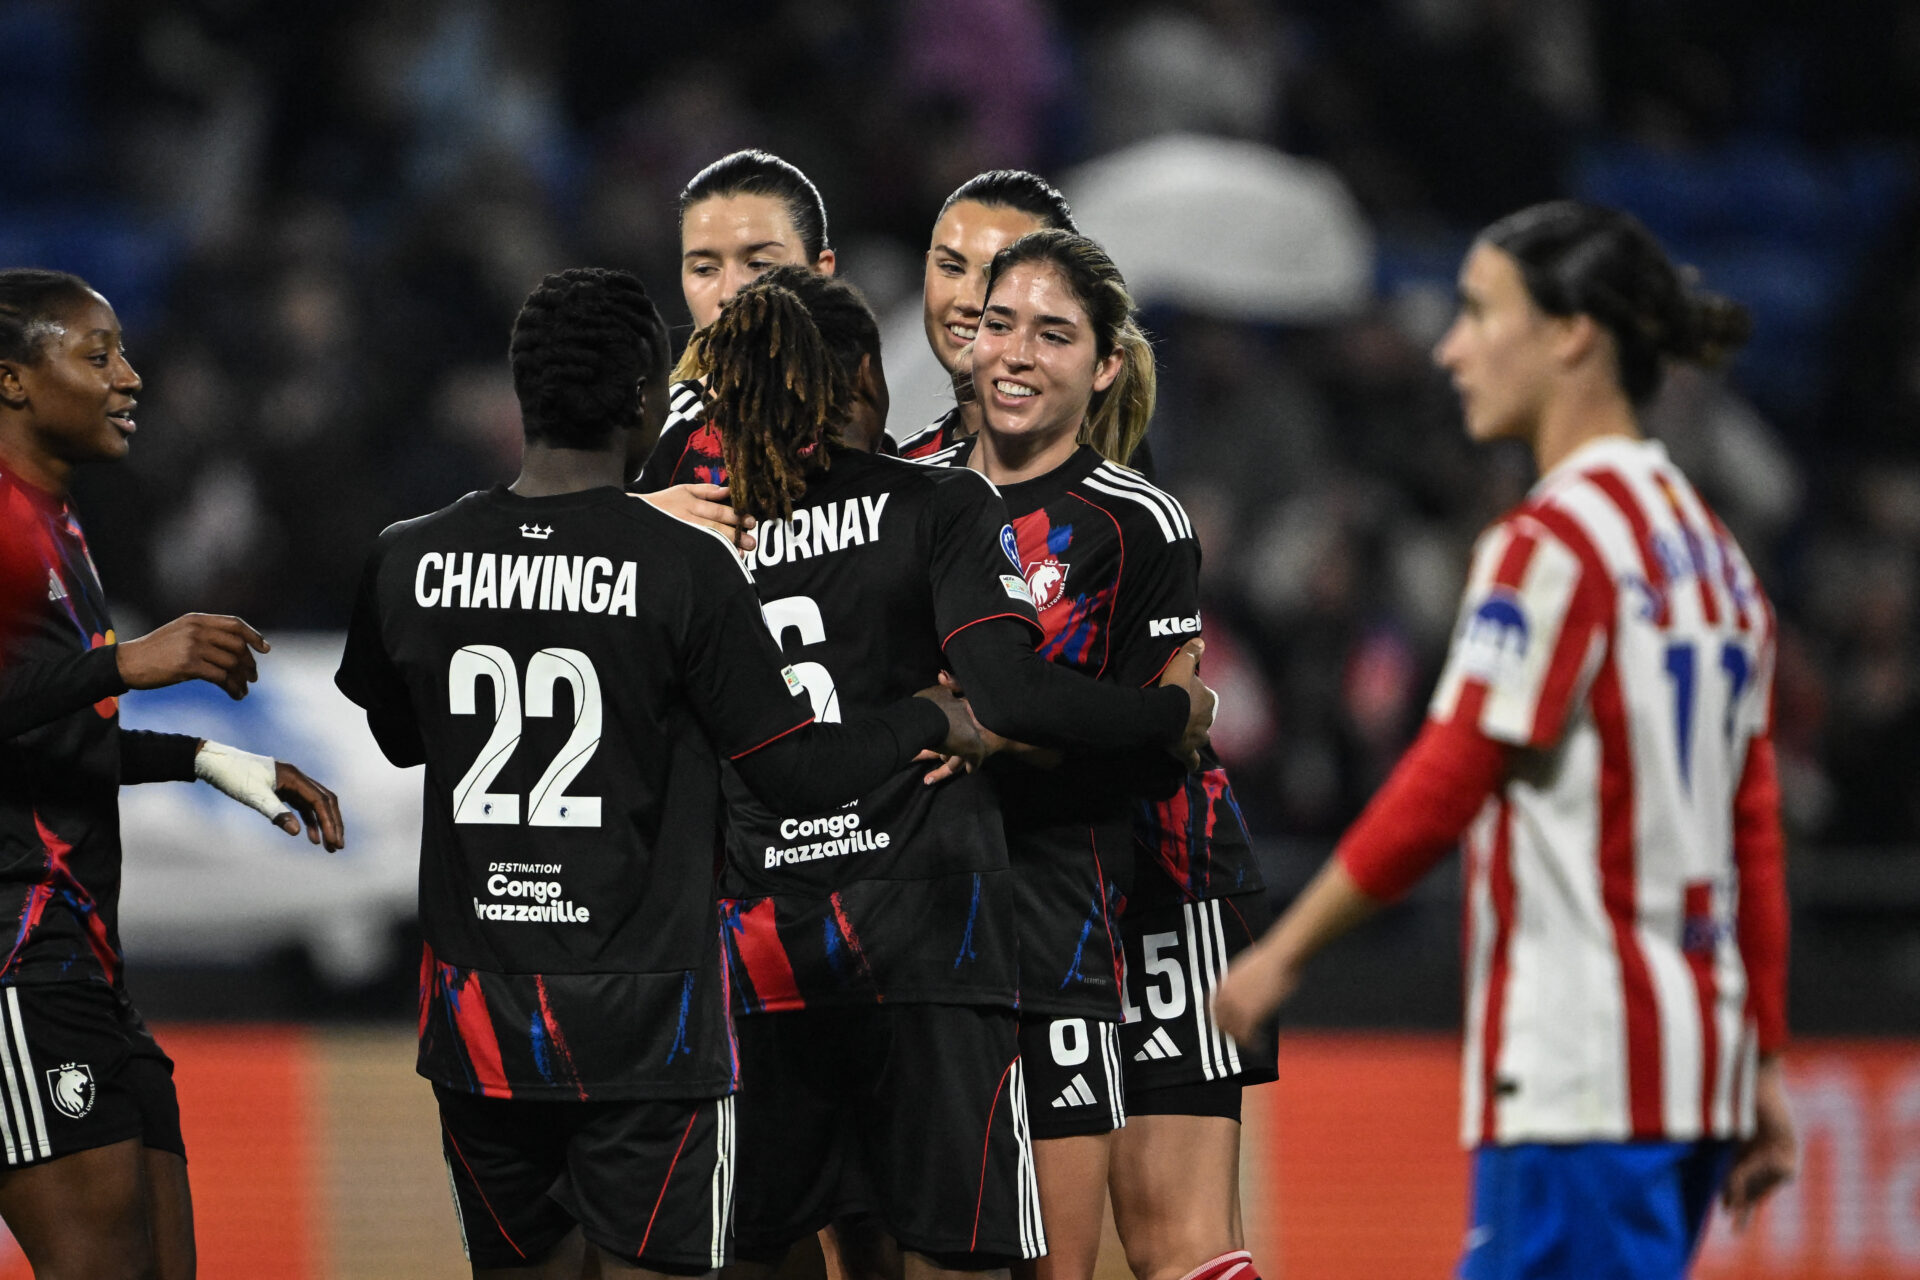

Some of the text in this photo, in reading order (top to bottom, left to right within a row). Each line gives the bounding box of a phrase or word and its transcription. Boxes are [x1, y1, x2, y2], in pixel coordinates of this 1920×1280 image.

[415, 552, 637, 617] CHAWINGA
[449, 644, 603, 827] 22
[780, 813, 860, 840] Congo
[764, 829, 891, 869] Brazzaville
[488, 862, 562, 874] DESTINATION
[487, 873, 562, 904] Congo
